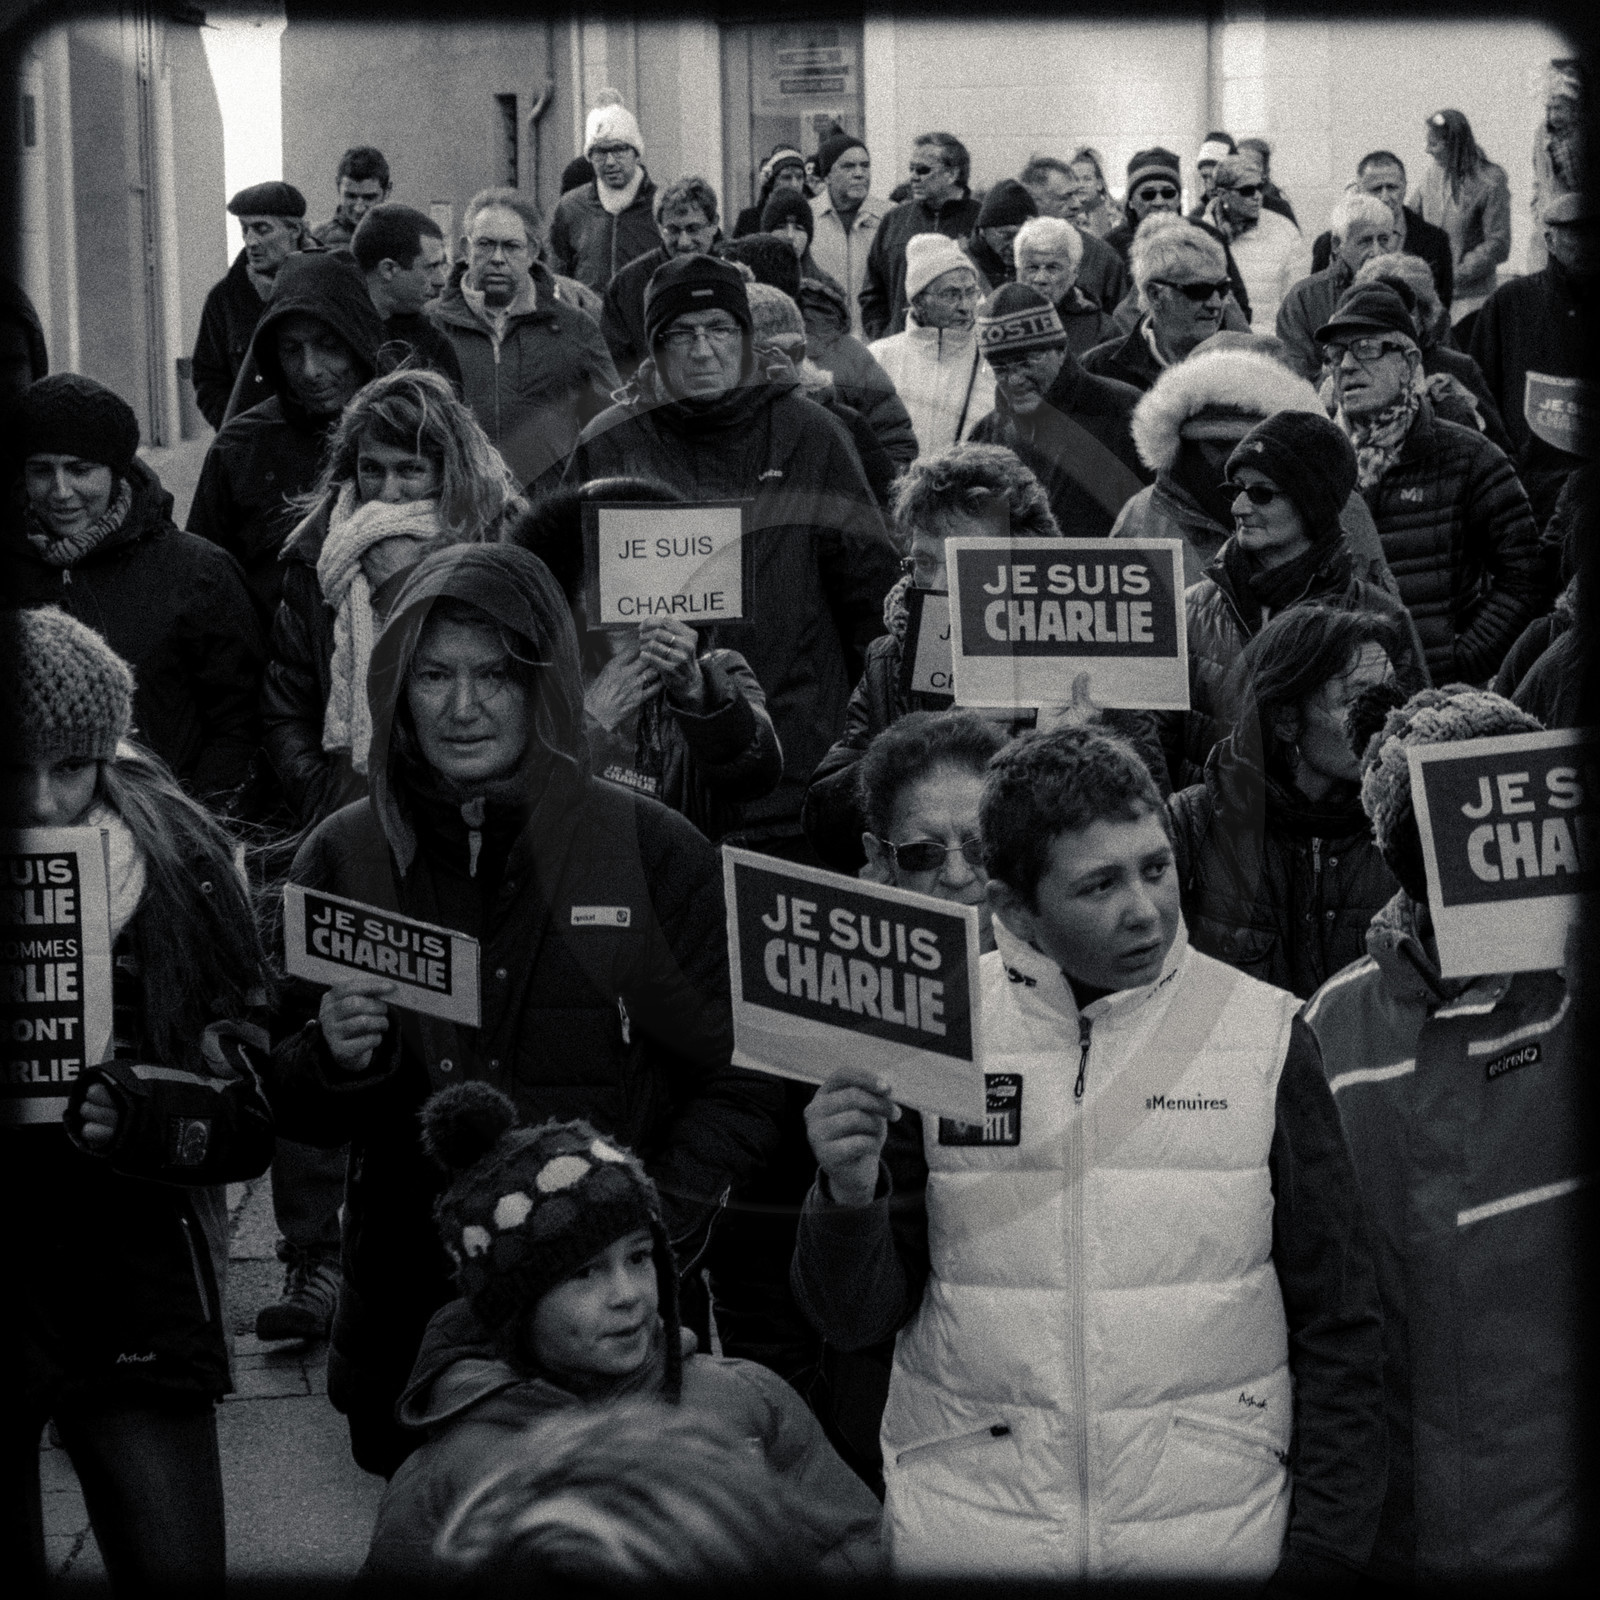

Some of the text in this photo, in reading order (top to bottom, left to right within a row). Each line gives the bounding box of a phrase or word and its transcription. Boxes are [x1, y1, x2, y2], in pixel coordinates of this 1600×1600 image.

[618, 535, 713, 559] JE SUIS
[983, 564, 1151, 595] JE SUIS
[617, 592, 725, 616] CHARLIE
[984, 600, 1155, 642] CHARLIE
[1460, 771, 1536, 819] JE
[312, 906, 446, 958] JE SUIS
[761, 893, 942, 970] JE SUIS
[312, 926, 447, 990] CHARLIE
[763, 937, 947, 1036] CHARLIE
[5, 1058, 81, 1083] RLIE
[1152, 1092, 1228, 1110] Menuires
[982, 1112, 1013, 1141] RTL
